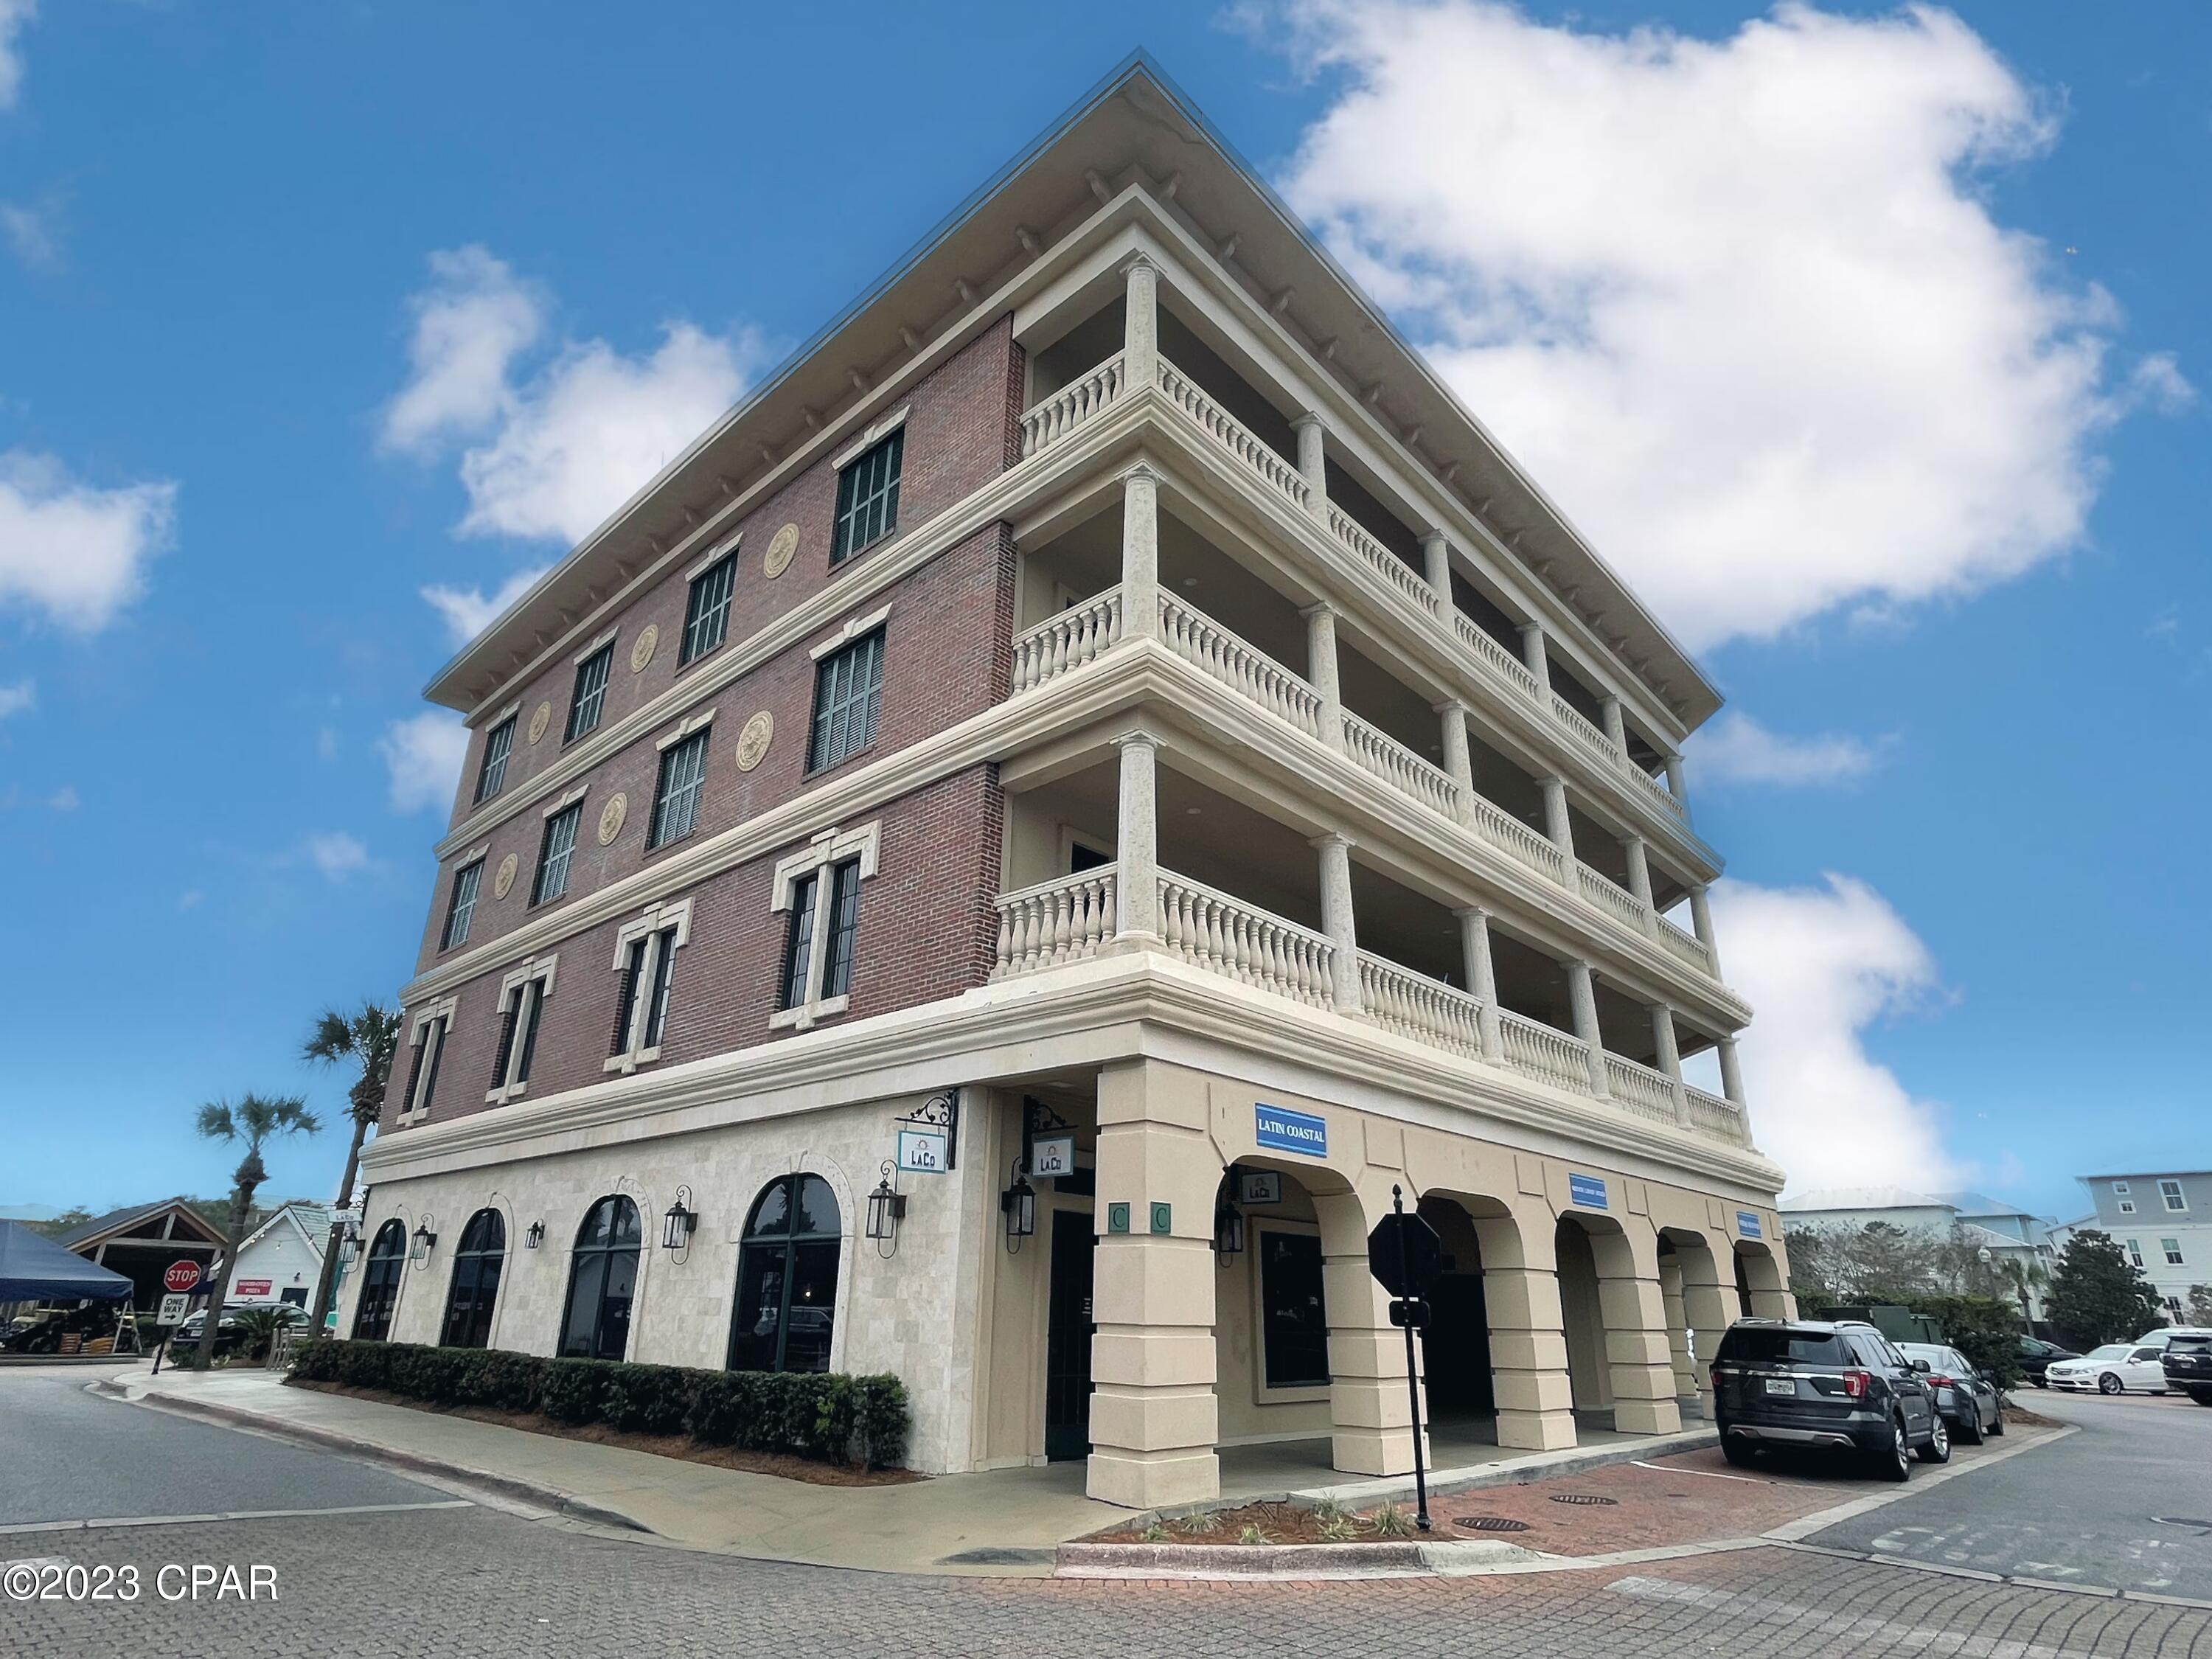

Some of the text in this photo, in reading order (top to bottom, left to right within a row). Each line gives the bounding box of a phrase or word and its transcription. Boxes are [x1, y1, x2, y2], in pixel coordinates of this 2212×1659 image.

[1258, 1118, 1325, 1143] LATIN COASTAL
[1113, 1207, 1126, 1228] C
[1156, 1207, 1168, 1228] C
[167, 1270, 198, 1281] STOP
